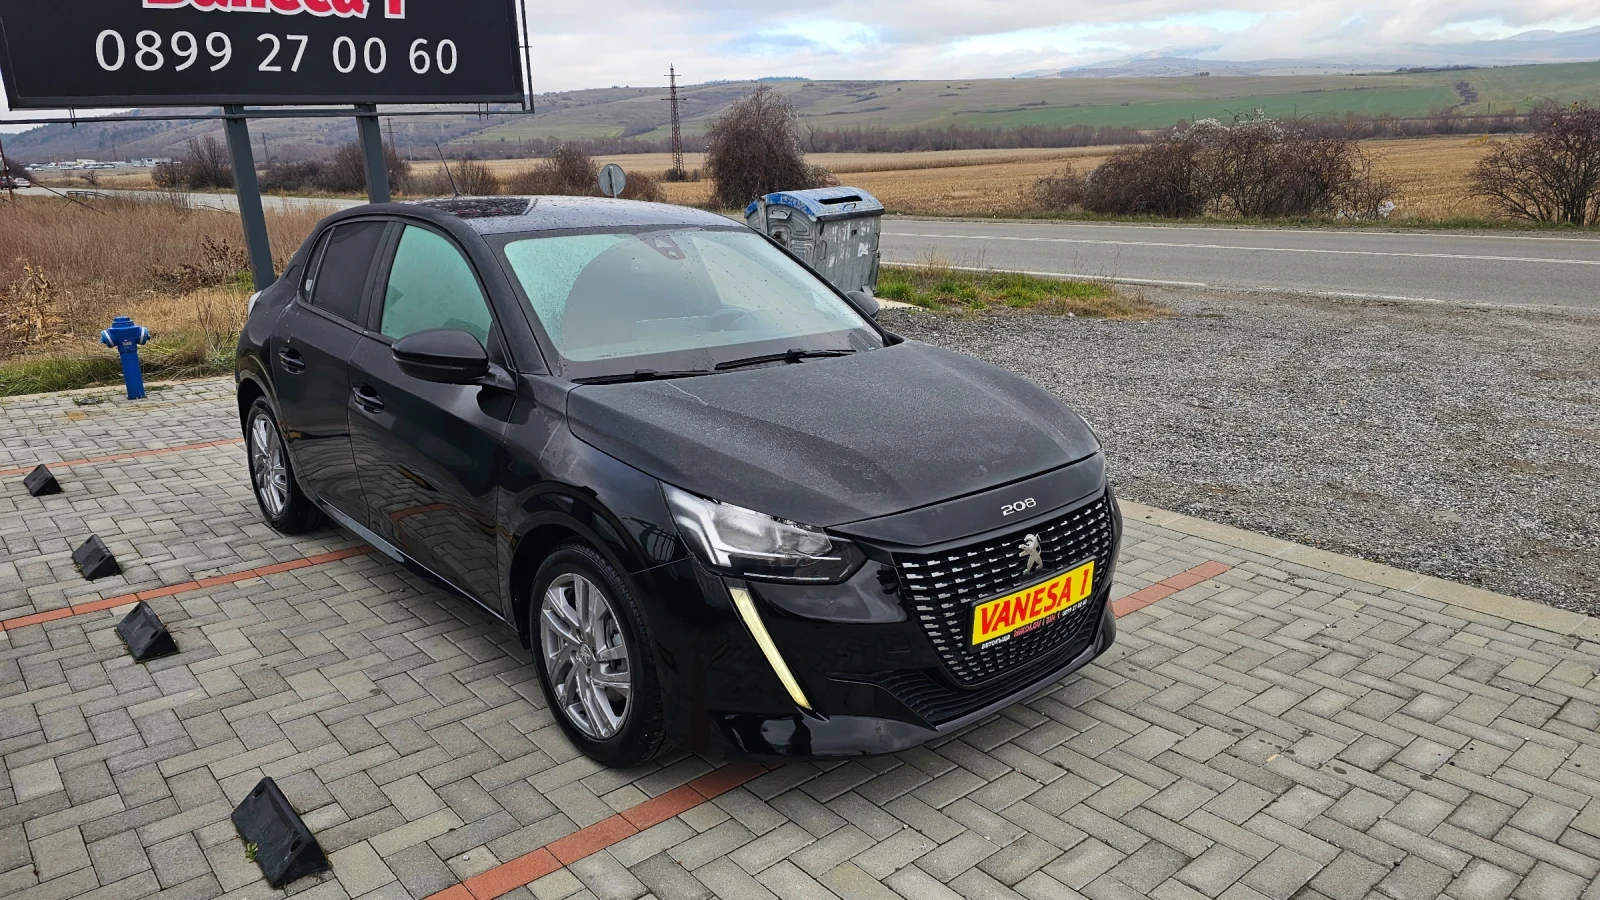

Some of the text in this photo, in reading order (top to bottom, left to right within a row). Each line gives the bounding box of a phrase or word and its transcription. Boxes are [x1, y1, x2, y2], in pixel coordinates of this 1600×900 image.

[95, 29, 458, 74] 0899 27 00 60
[1001, 497, 1037, 516] 208
[980, 569, 1089, 635] VANESA 1
